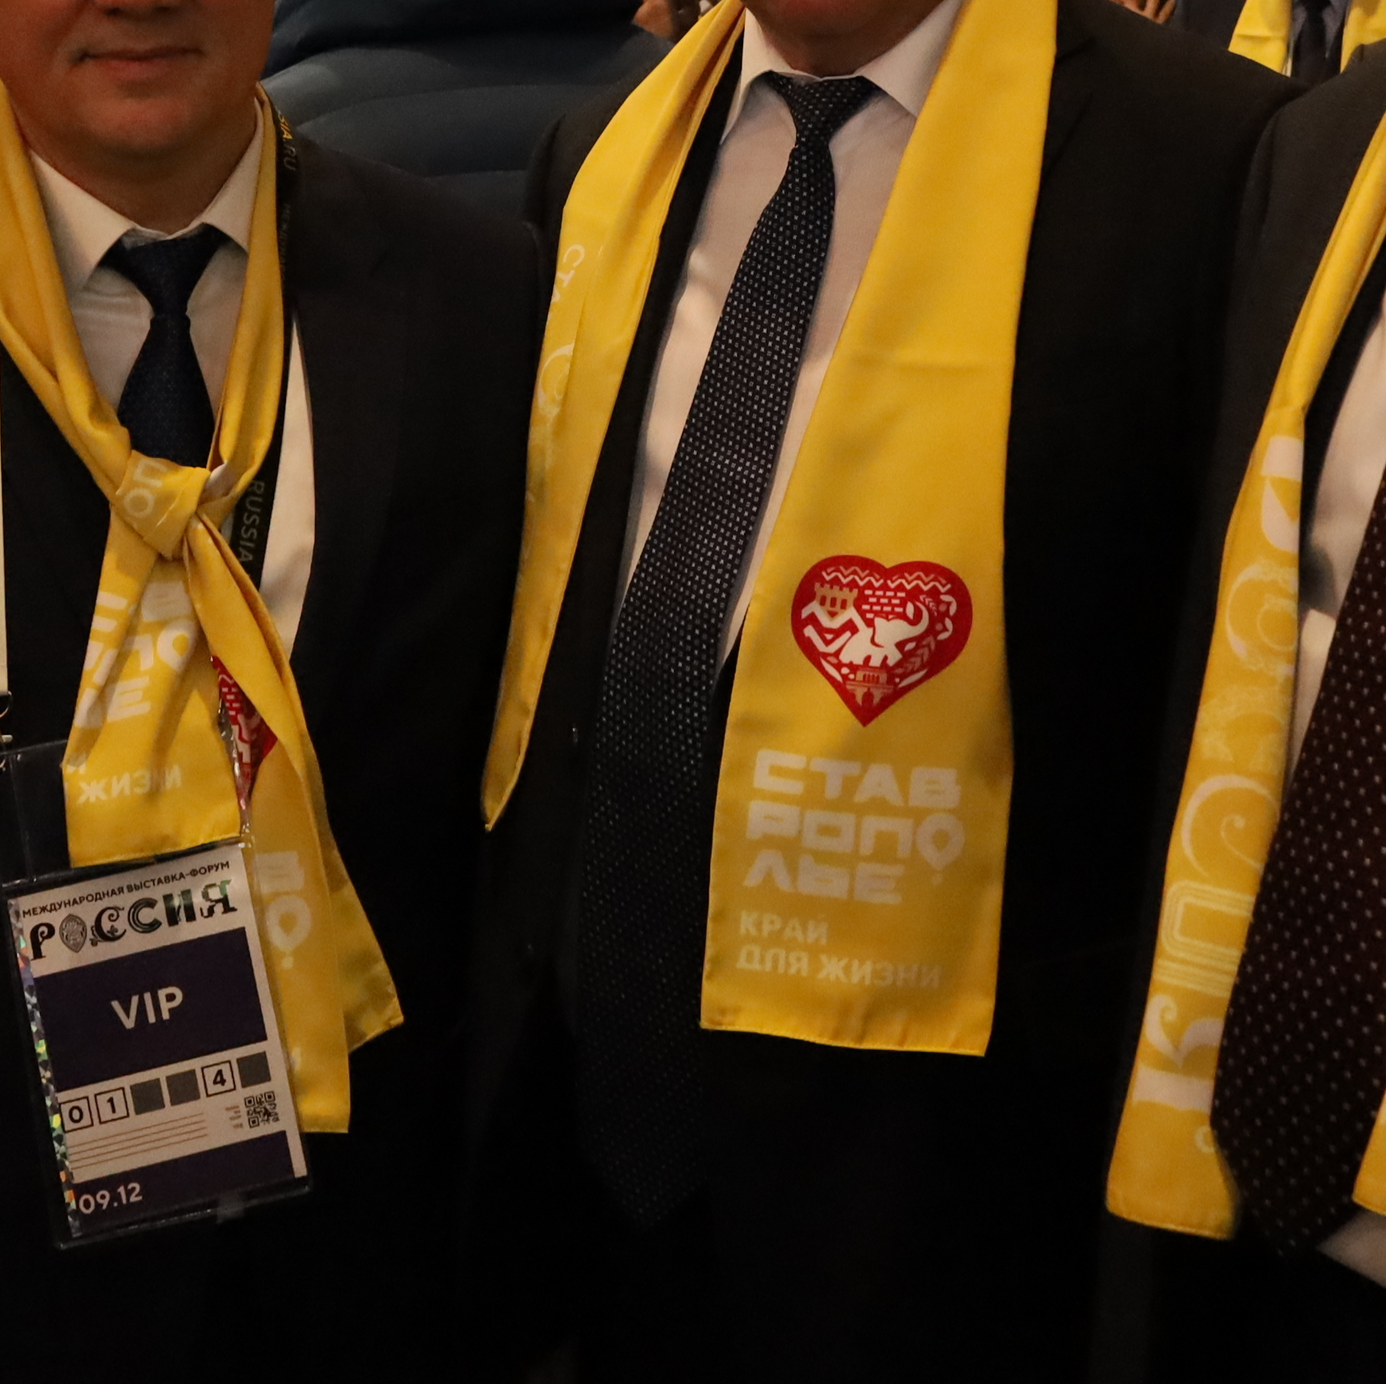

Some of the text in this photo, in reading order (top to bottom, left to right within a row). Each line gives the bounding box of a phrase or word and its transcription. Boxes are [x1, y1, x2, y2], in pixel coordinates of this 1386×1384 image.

[753, 747, 964, 810] СТАВ
[745, 799, 967, 874] РОПО
[21, 887, 126, 920] МЕЖДУНАРОДНАЯ
[125, 860, 231, 895] ВЫСТАВКА-ФОРУМ
[741, 847, 907, 907] ЛЬЕ
[29, 879, 239, 962] РОССИЯ
[739, 910, 829, 947] КРАЙ
[735, 941, 944, 991] ДЛЯ ЖИЗНИ
[110, 985, 184, 1030] VIP
[68, 1069, 227, 1124] 0 1 4
[78, 1181, 144, 1215] 09.12
